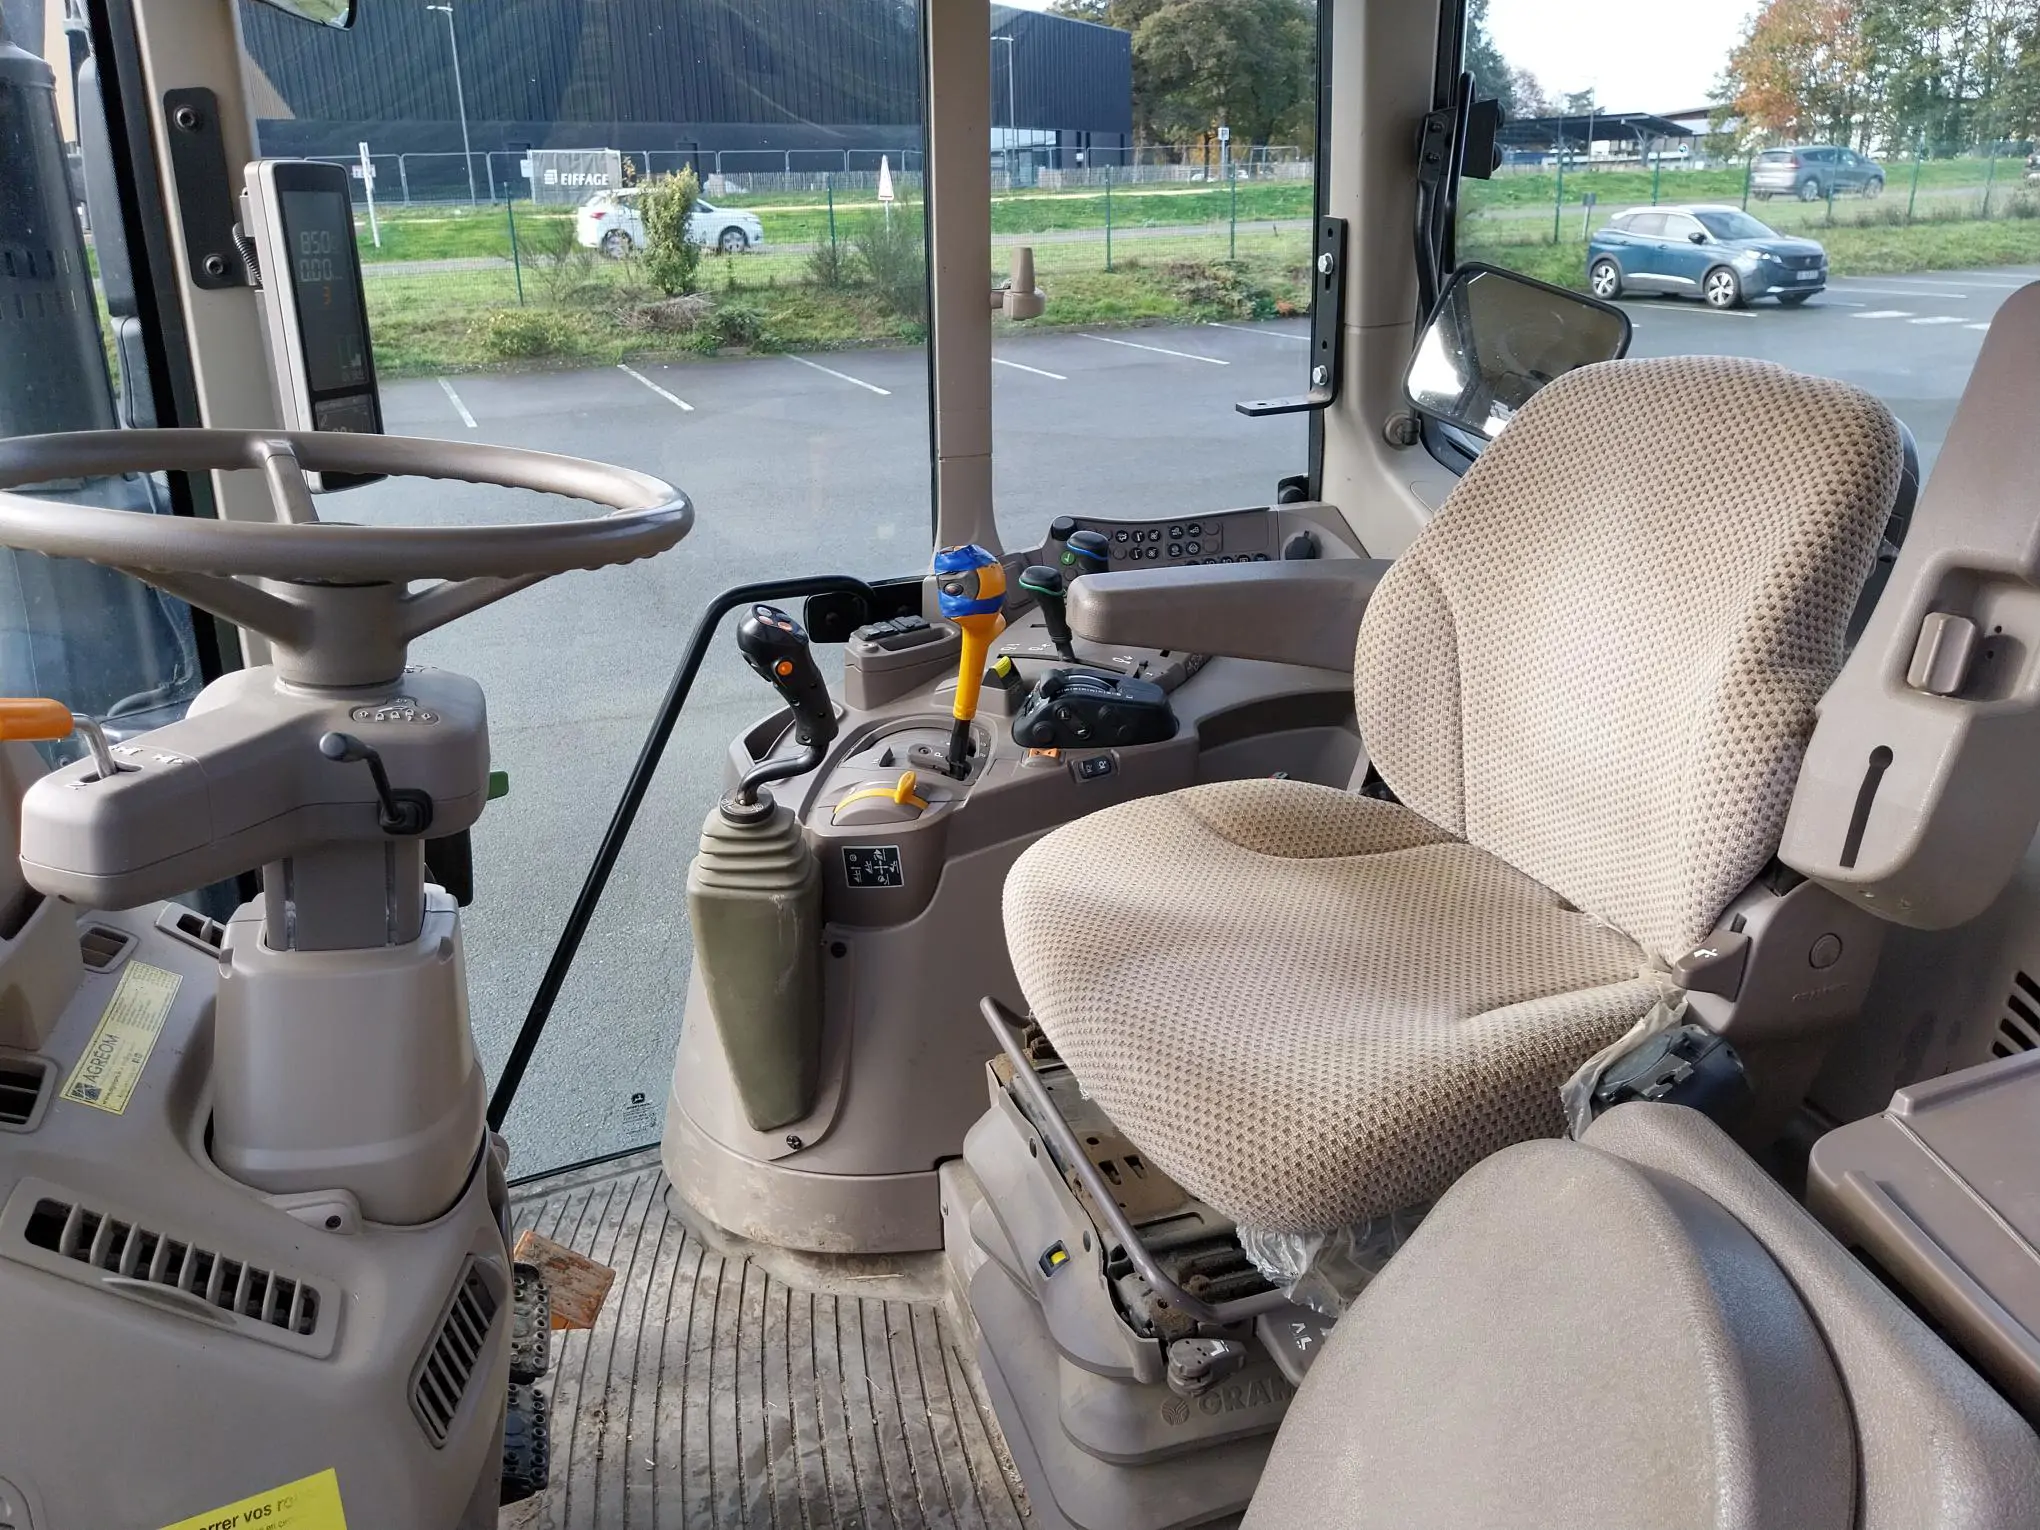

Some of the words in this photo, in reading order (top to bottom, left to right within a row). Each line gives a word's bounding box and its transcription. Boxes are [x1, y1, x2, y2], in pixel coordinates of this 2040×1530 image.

[560, 173, 609, 186] EIFFAGE
[300, 230, 331, 254] 850
[243, 1504, 272, 1523] vos
